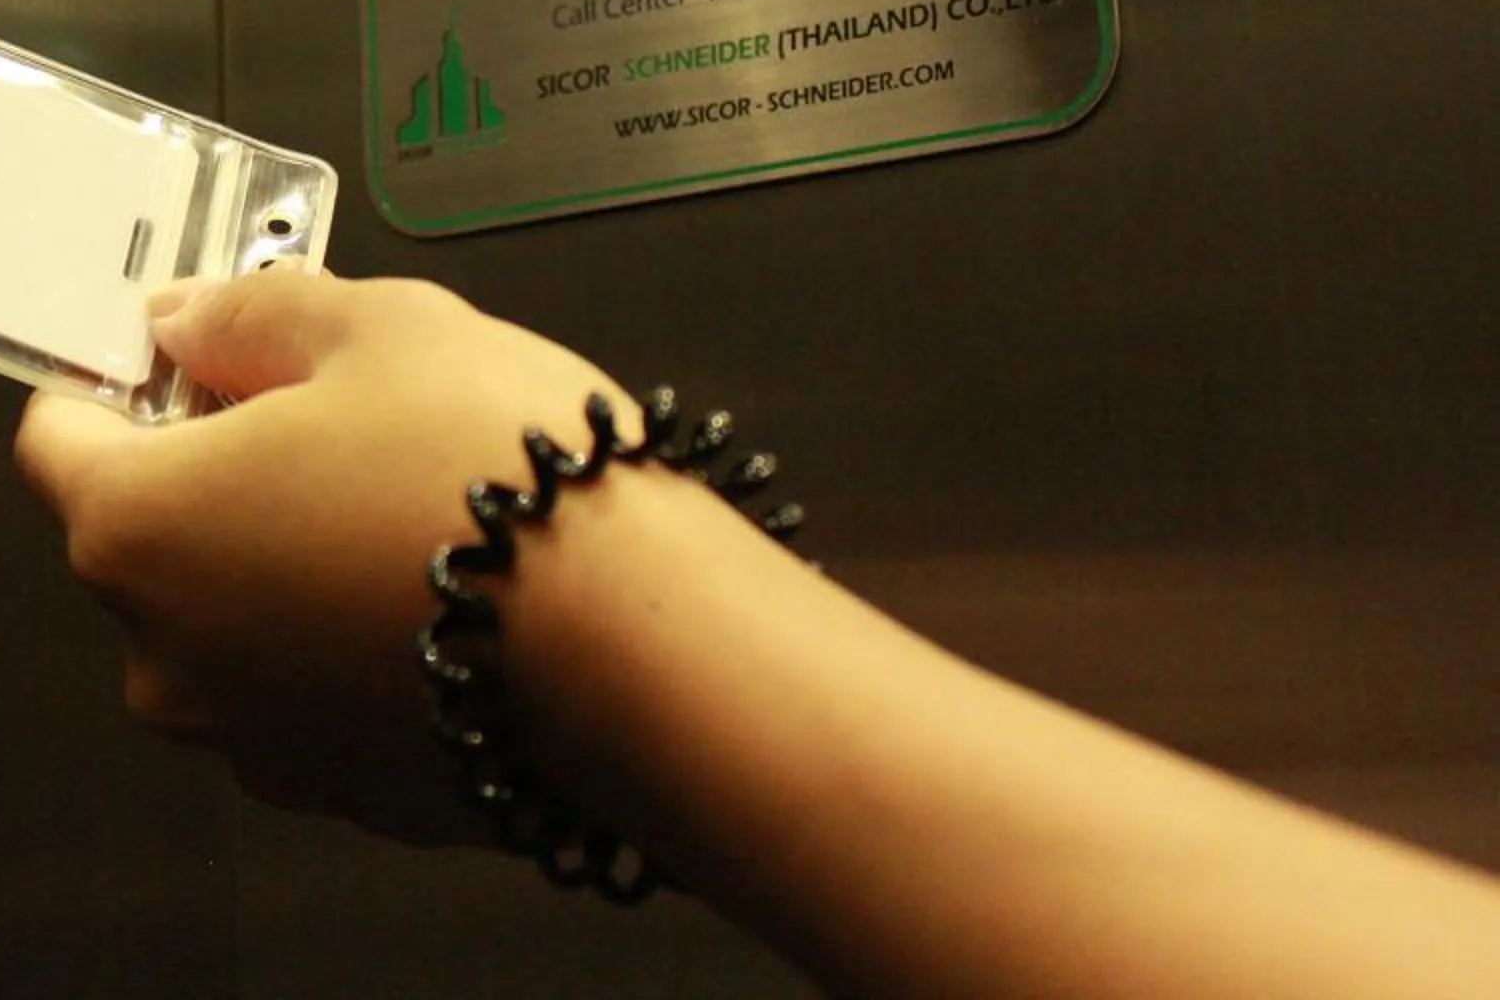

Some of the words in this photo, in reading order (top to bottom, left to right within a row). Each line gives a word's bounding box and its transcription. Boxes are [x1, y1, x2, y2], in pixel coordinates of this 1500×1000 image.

[536, 64, 612, 98] SICOR
[622, 34, 771, 79] SCHNEIDER
[776, 3, 937, 57] (THAILAND)
